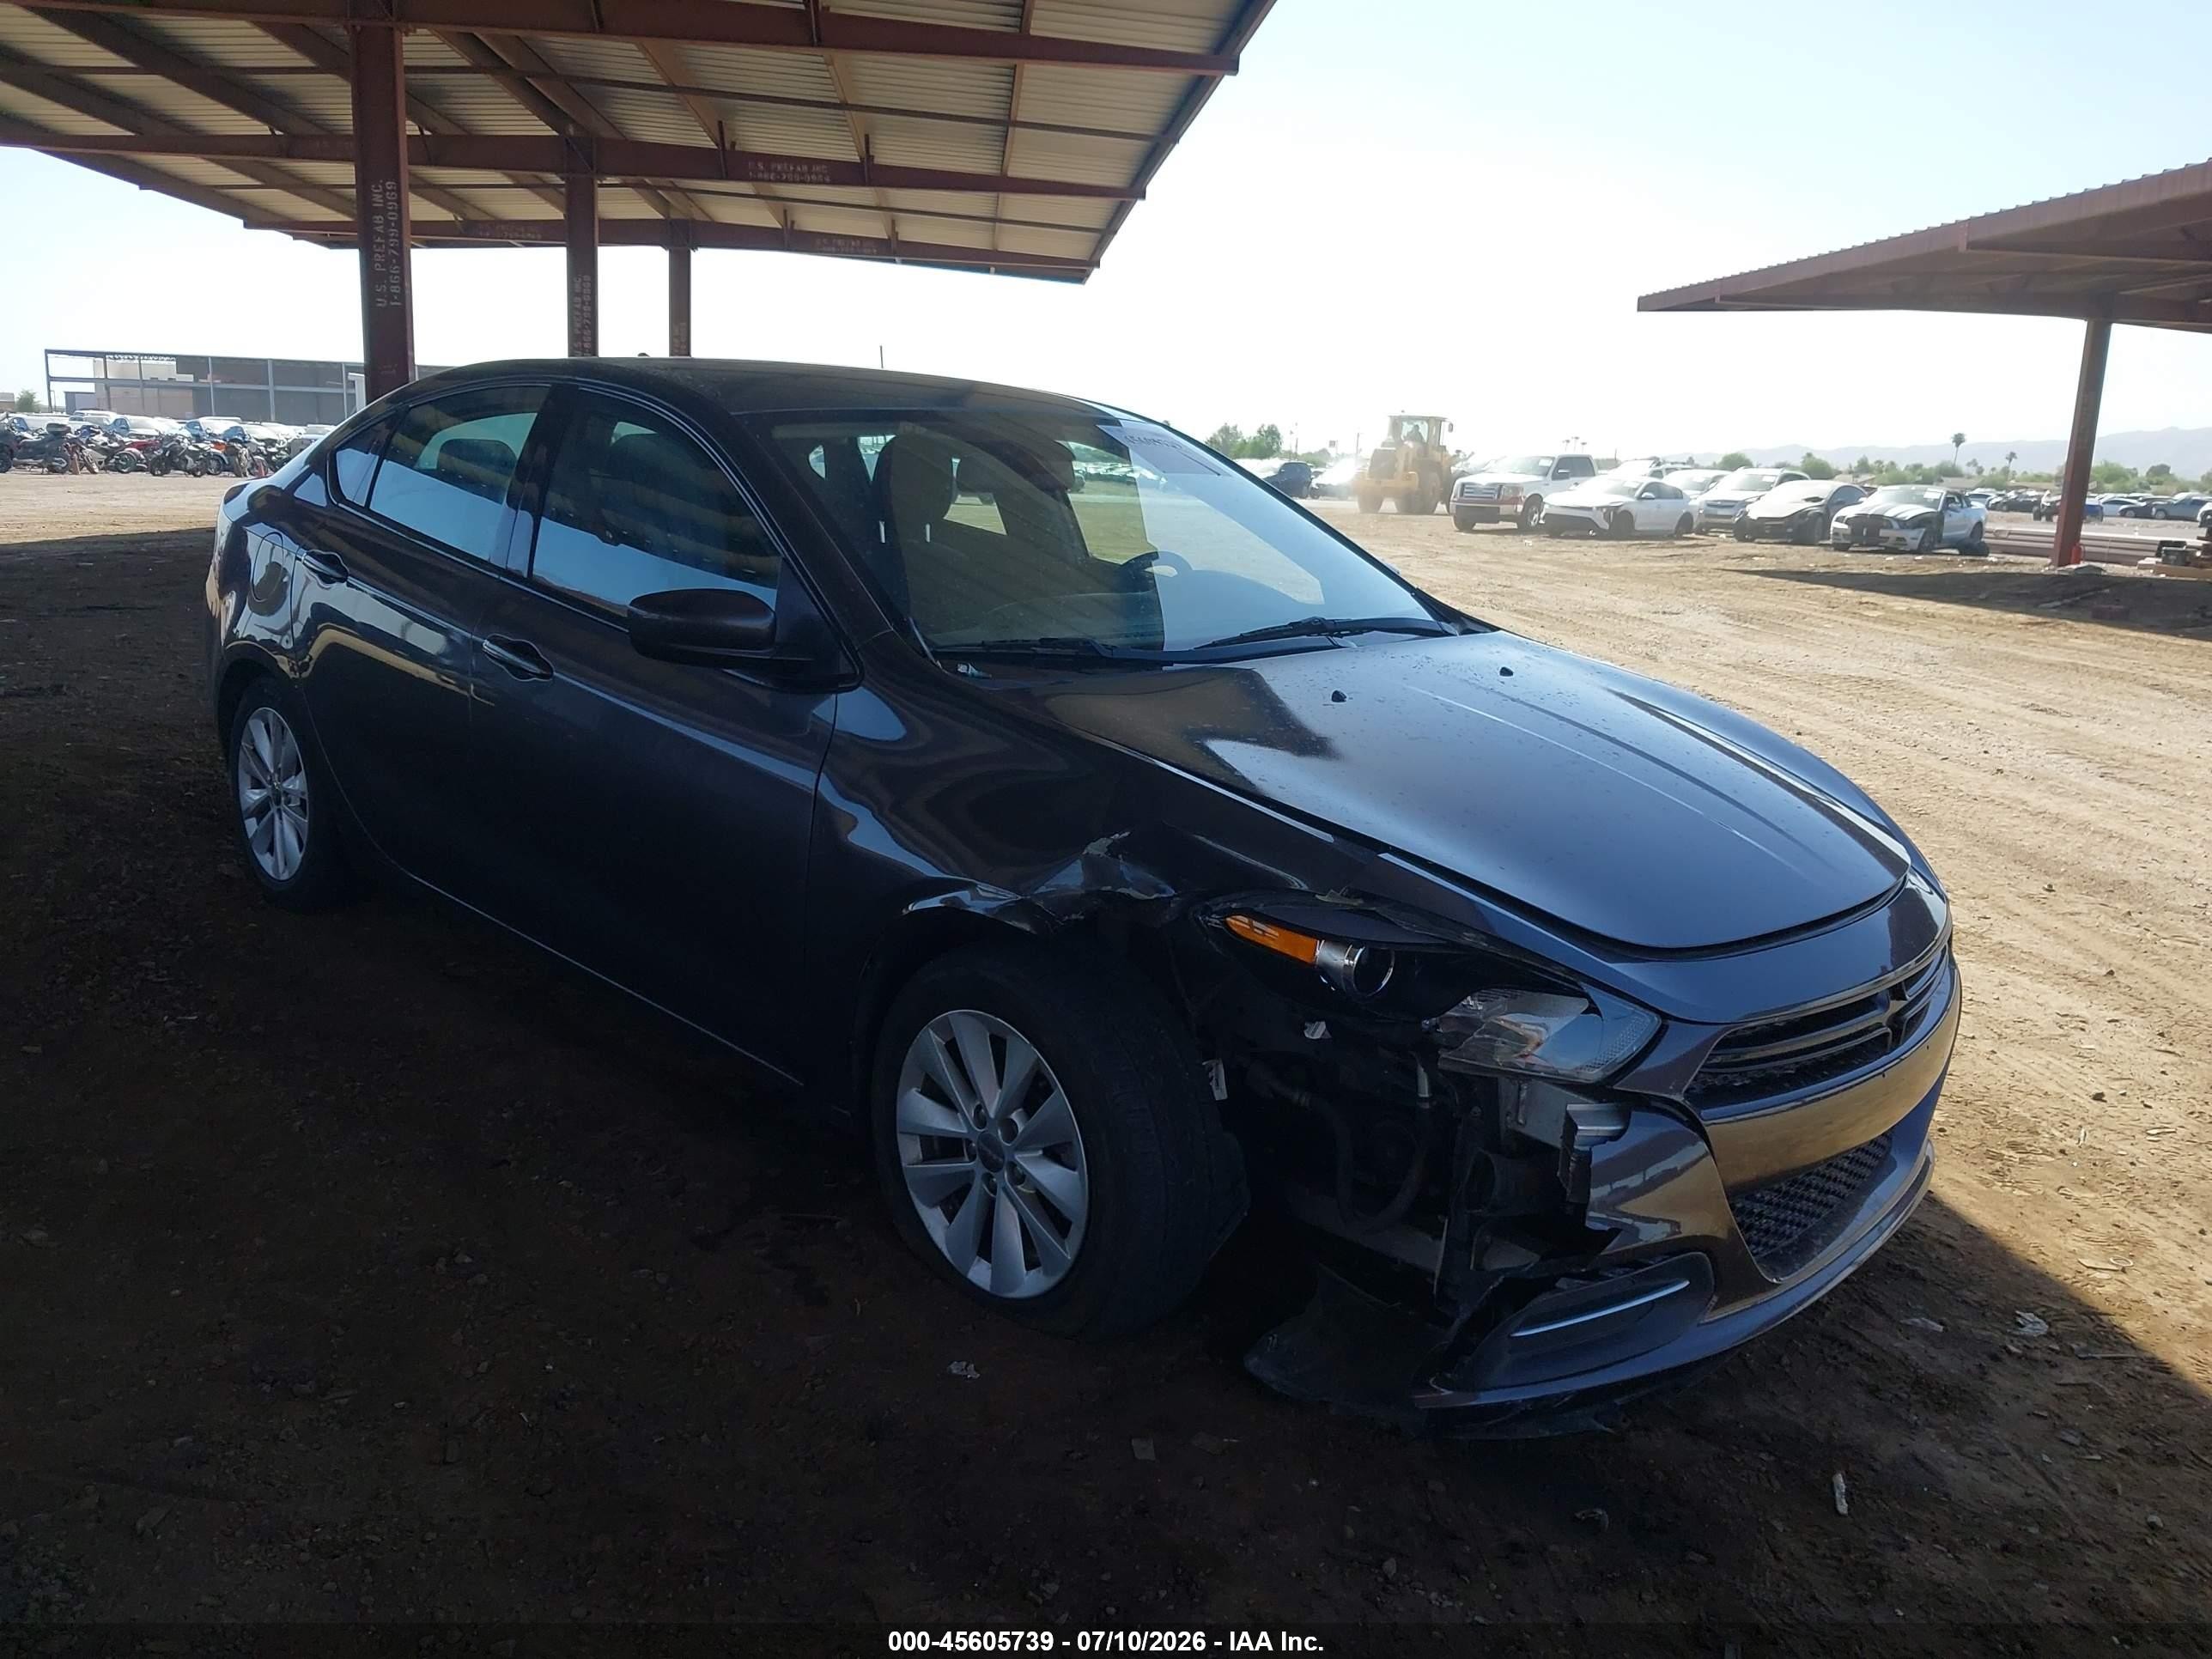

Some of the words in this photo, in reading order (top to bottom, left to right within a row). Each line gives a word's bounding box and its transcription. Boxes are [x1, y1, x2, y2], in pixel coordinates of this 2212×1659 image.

[371, 179, 384, 206] INC.
[372, 215, 386, 271] PREFAB
[385, 180, 402, 307] 1-866-799-0969
[375, 279, 387, 307] U.S.
